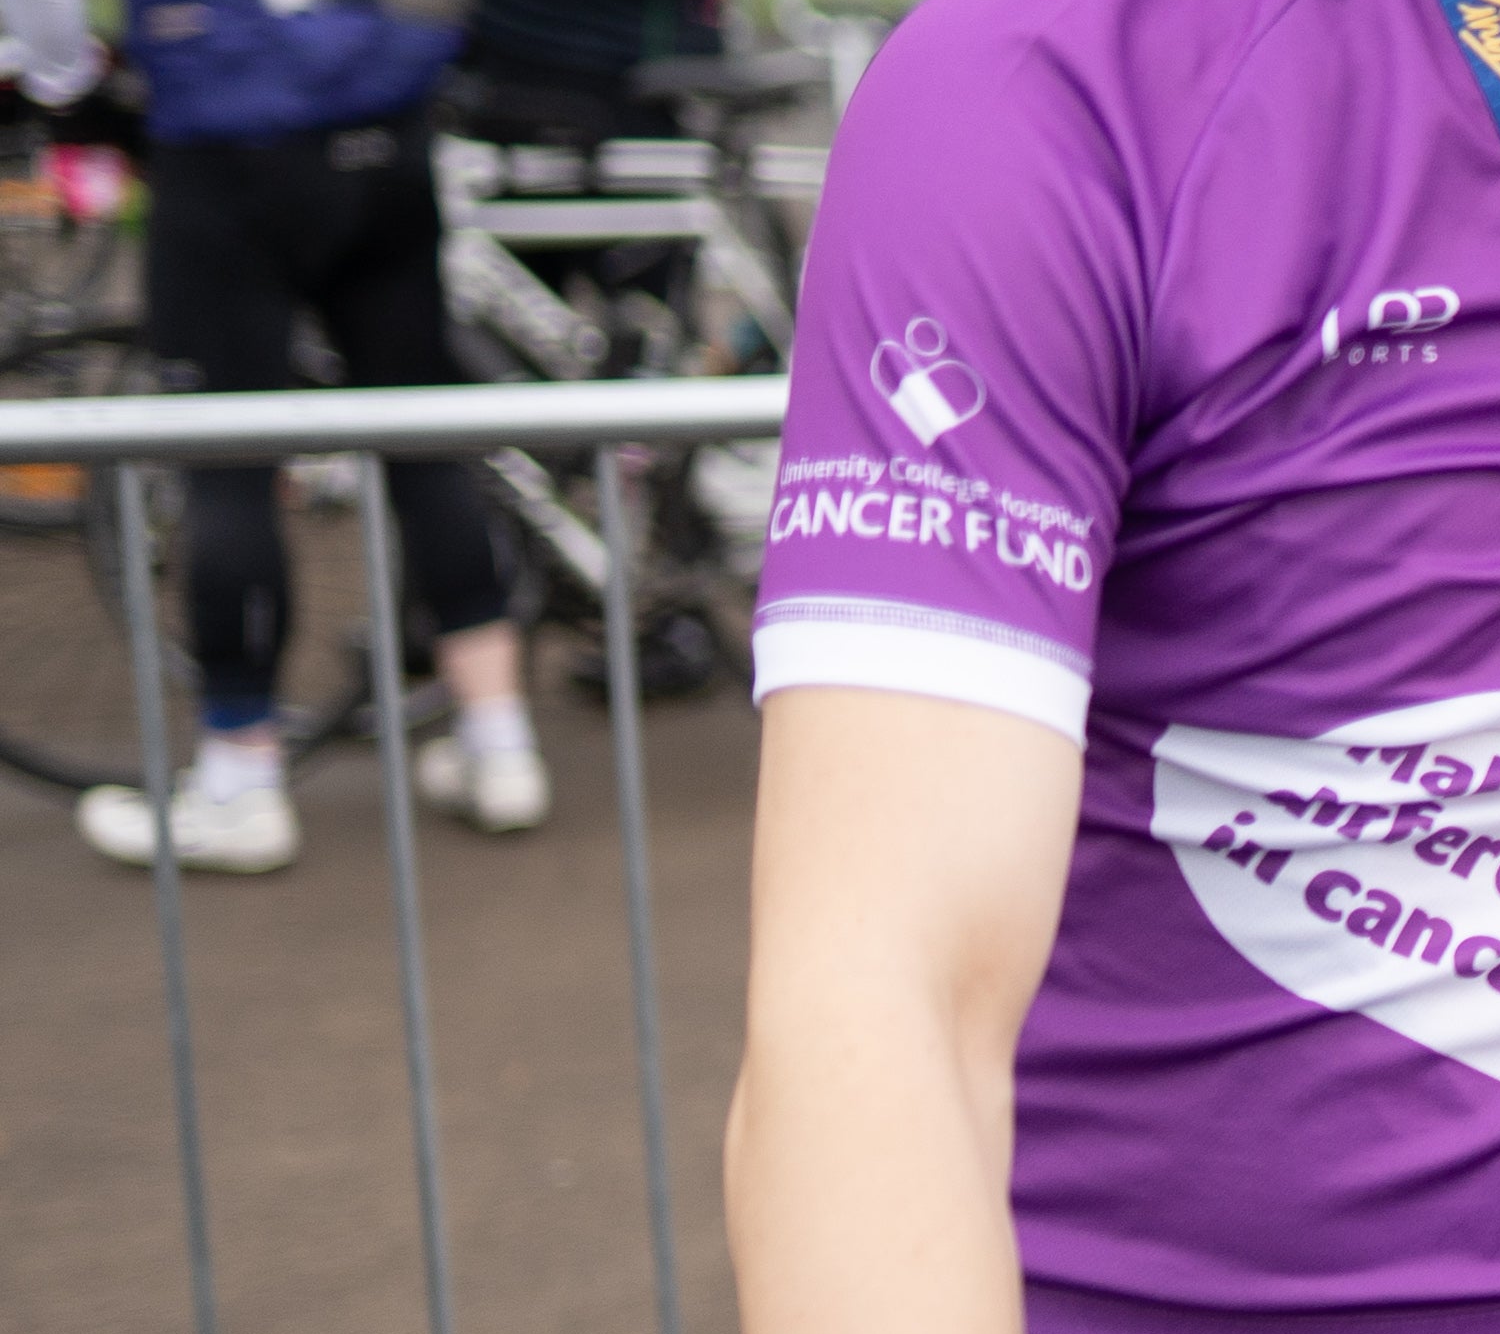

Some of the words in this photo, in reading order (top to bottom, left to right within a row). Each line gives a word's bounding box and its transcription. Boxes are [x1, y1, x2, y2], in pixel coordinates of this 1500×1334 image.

[889, 456, 990, 503] College
[770, 490, 952, 548] CANCER
[964, 510, 1093, 591] FUND
